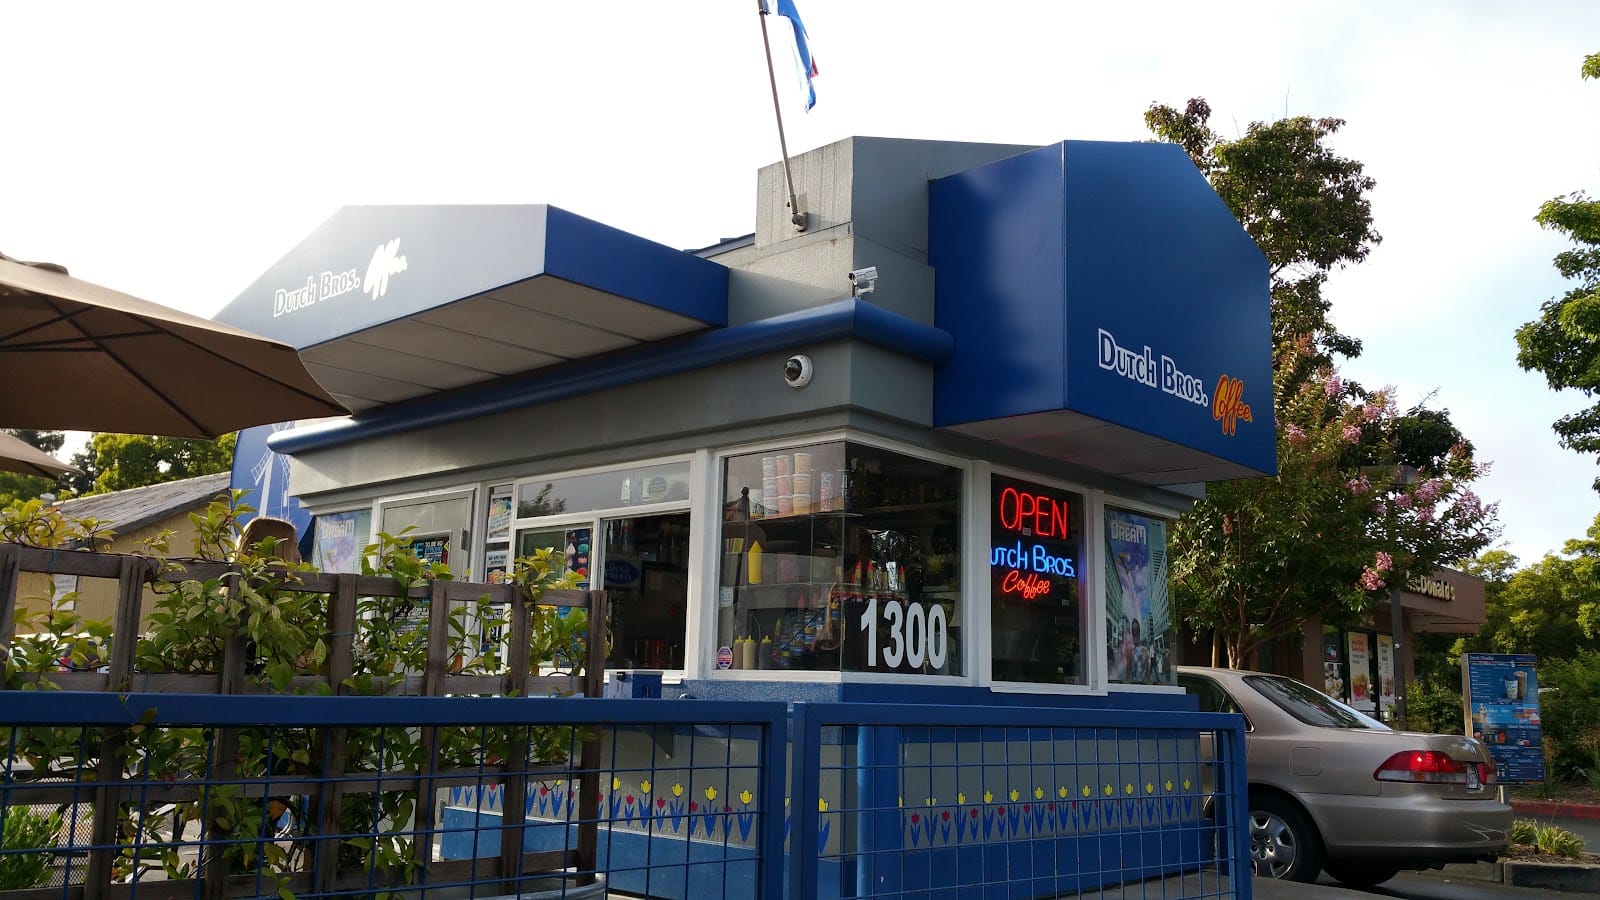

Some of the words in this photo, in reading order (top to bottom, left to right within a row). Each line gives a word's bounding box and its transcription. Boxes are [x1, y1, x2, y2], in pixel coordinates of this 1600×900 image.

[1212, 374, 1252, 436] Coffee
[1000, 487, 1067, 539] OPEN
[1111, 520, 1147, 544] DREAM
[989, 540, 1029, 570] UTCH
[1003, 570, 1051, 600] Coffee
[861, 598, 947, 669] 1300
